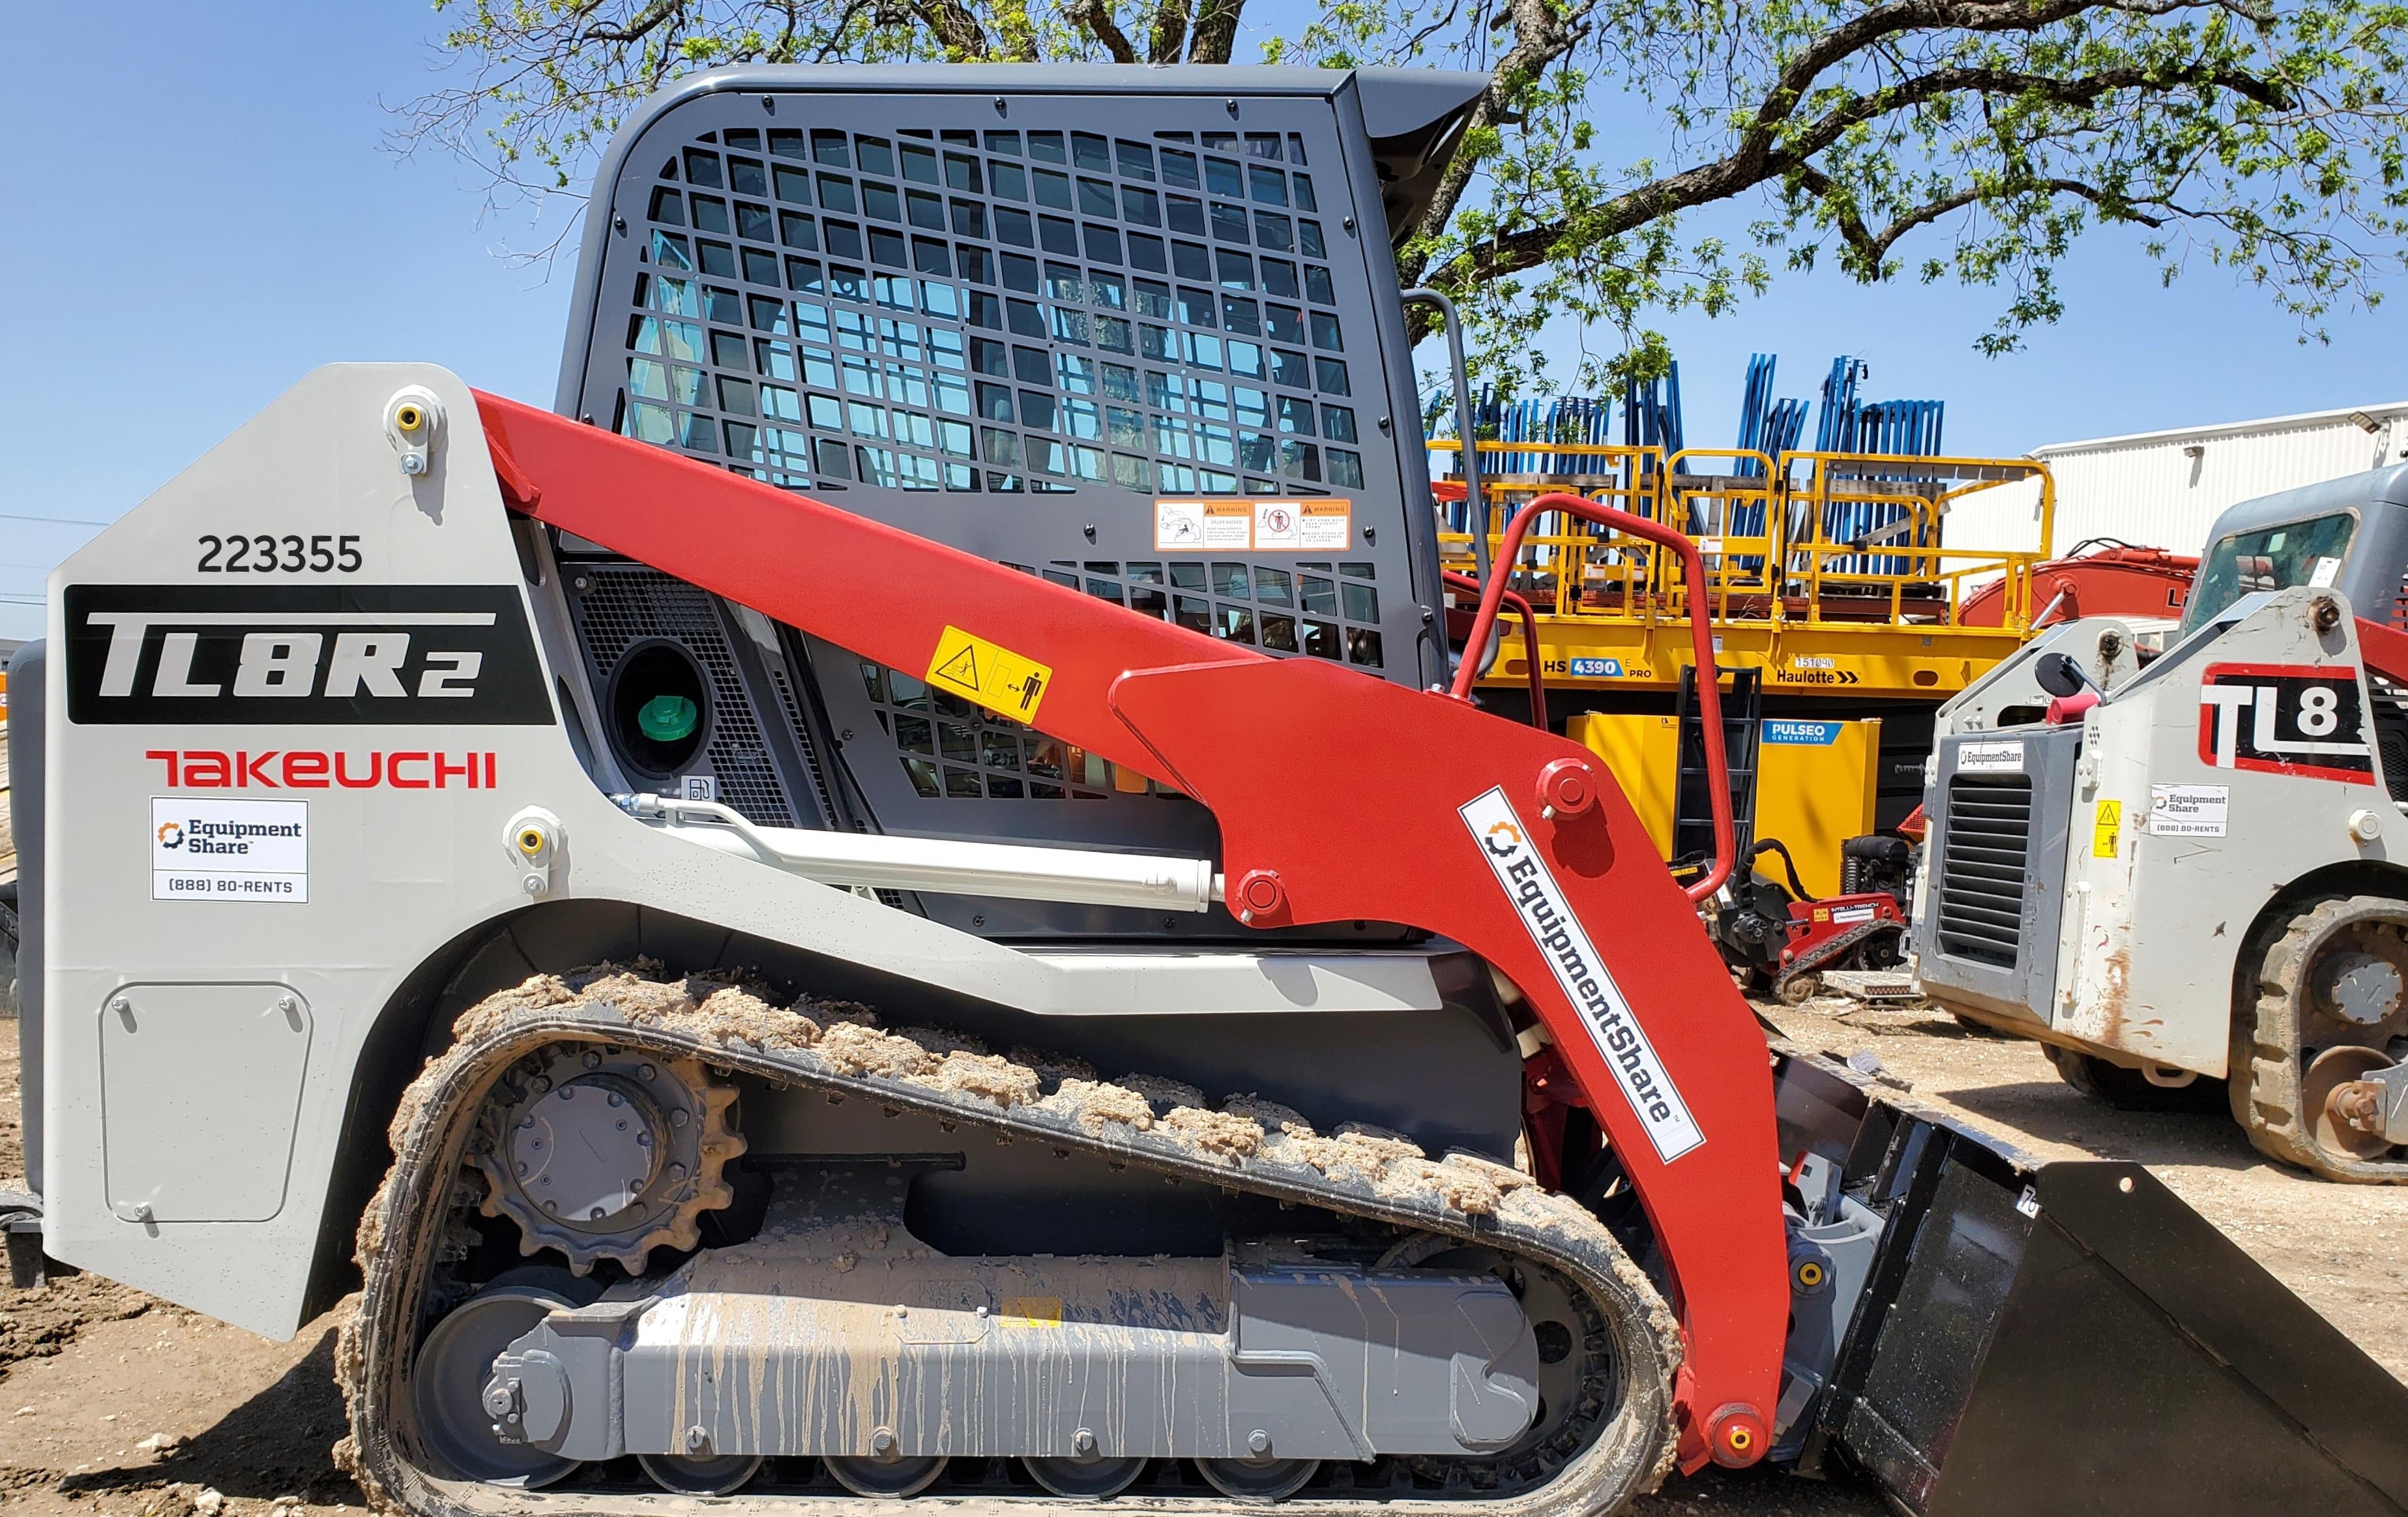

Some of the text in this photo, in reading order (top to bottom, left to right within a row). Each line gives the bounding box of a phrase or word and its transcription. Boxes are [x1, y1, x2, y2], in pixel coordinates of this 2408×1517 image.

[198, 535, 363, 574] 223355
[86, 612, 497, 698] TL8R2
[1544, 660, 1617, 674] HS 4390
[1797, 658, 1834, 668] 151090
[1630, 670, 1652, 678] PRO
[1777, 670, 1835, 684] Haulotte
[1772, 724, 1825, 736] PULSEO
[2201, 685, 2371, 769] TL8
[1967, 750, 2021, 765] EquipmentShare
[2169, 794, 2226, 805] Equipment
[2168, 804, 2199, 813] Share
[188, 819, 302, 840] Equipment
[2181, 825, 2220, 833] 80-RENTS
[169, 878, 293, 893] (888) 80-RENTS
[2020, 1188, 2037, 1213] 76
